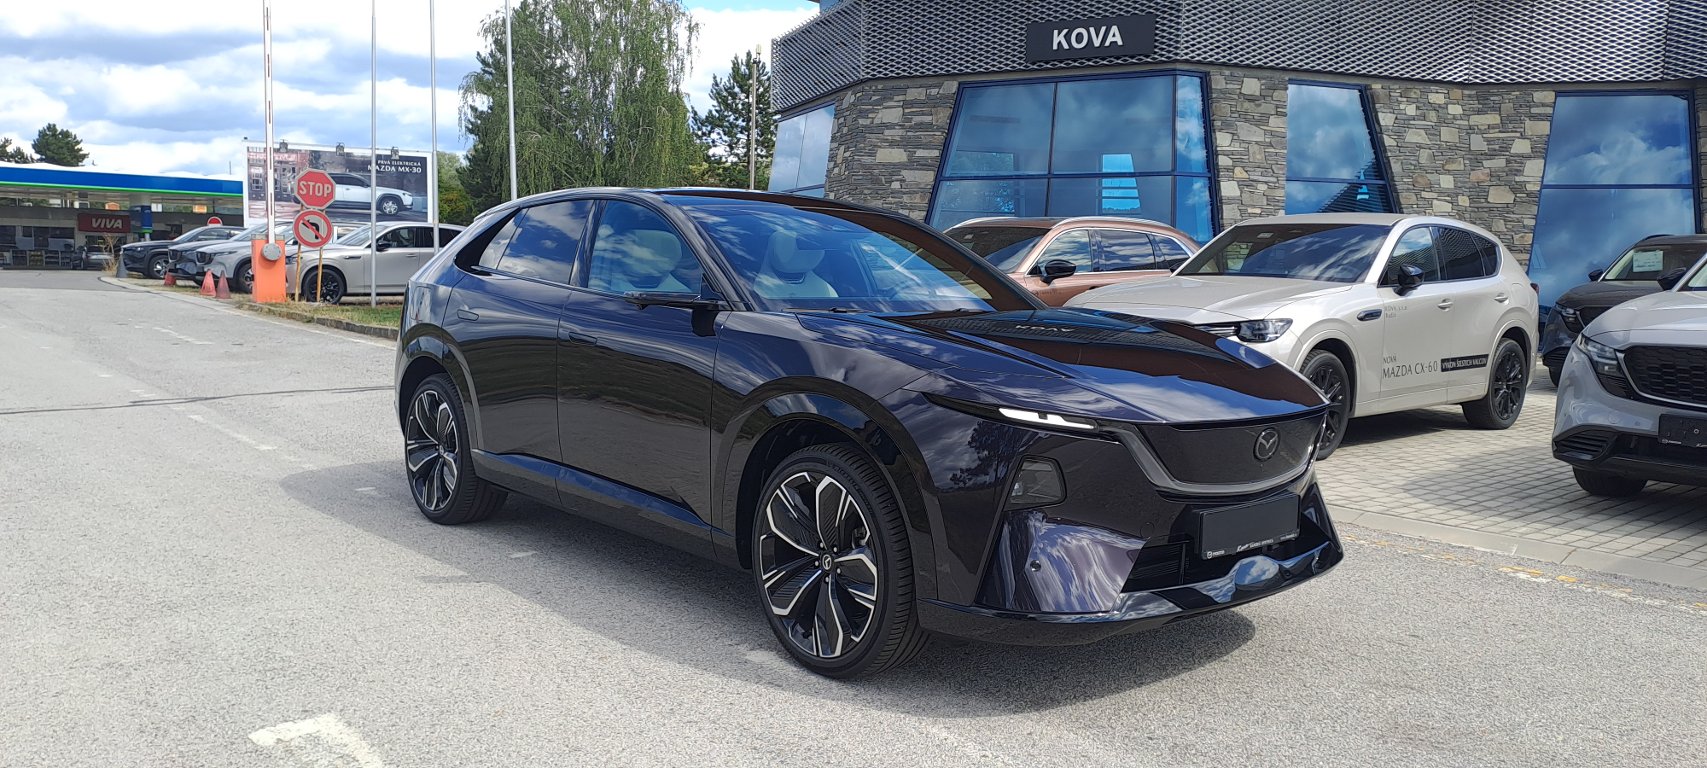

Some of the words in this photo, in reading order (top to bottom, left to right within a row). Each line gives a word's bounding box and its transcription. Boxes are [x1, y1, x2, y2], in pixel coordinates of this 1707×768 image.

[1052, 25, 1123, 50] KOVA
[367, 164, 396, 172] MAZDA
[299, 181, 332, 197] STOP
[91, 218, 122, 229] VIVA
[1383, 364, 1412, 379] MAZDA
[1414, 360, 1438, 375] CX-60
